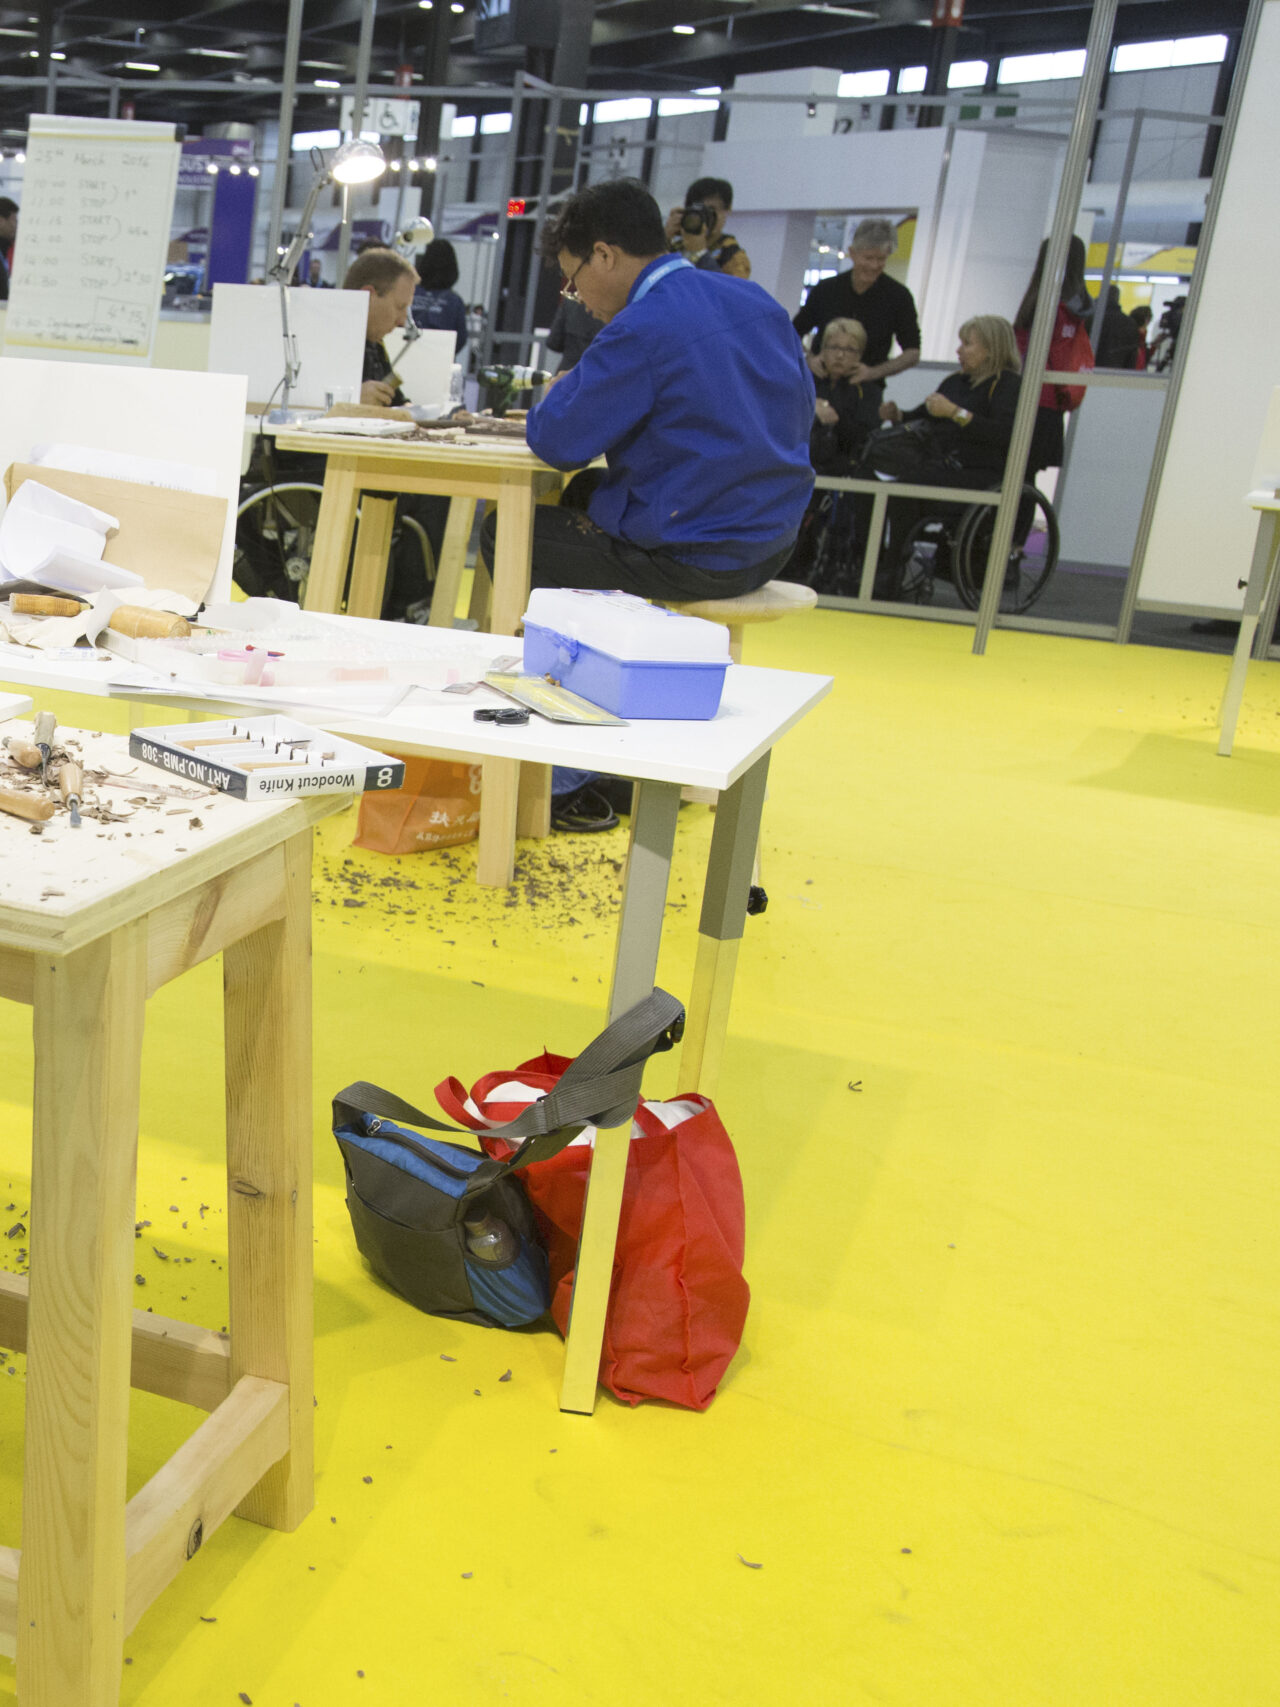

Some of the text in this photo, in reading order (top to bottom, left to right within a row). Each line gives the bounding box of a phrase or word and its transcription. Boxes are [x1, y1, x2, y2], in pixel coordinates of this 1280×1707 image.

[259, 774, 355, 791] Woodcut Knife
[376, 767, 394, 788] 8
